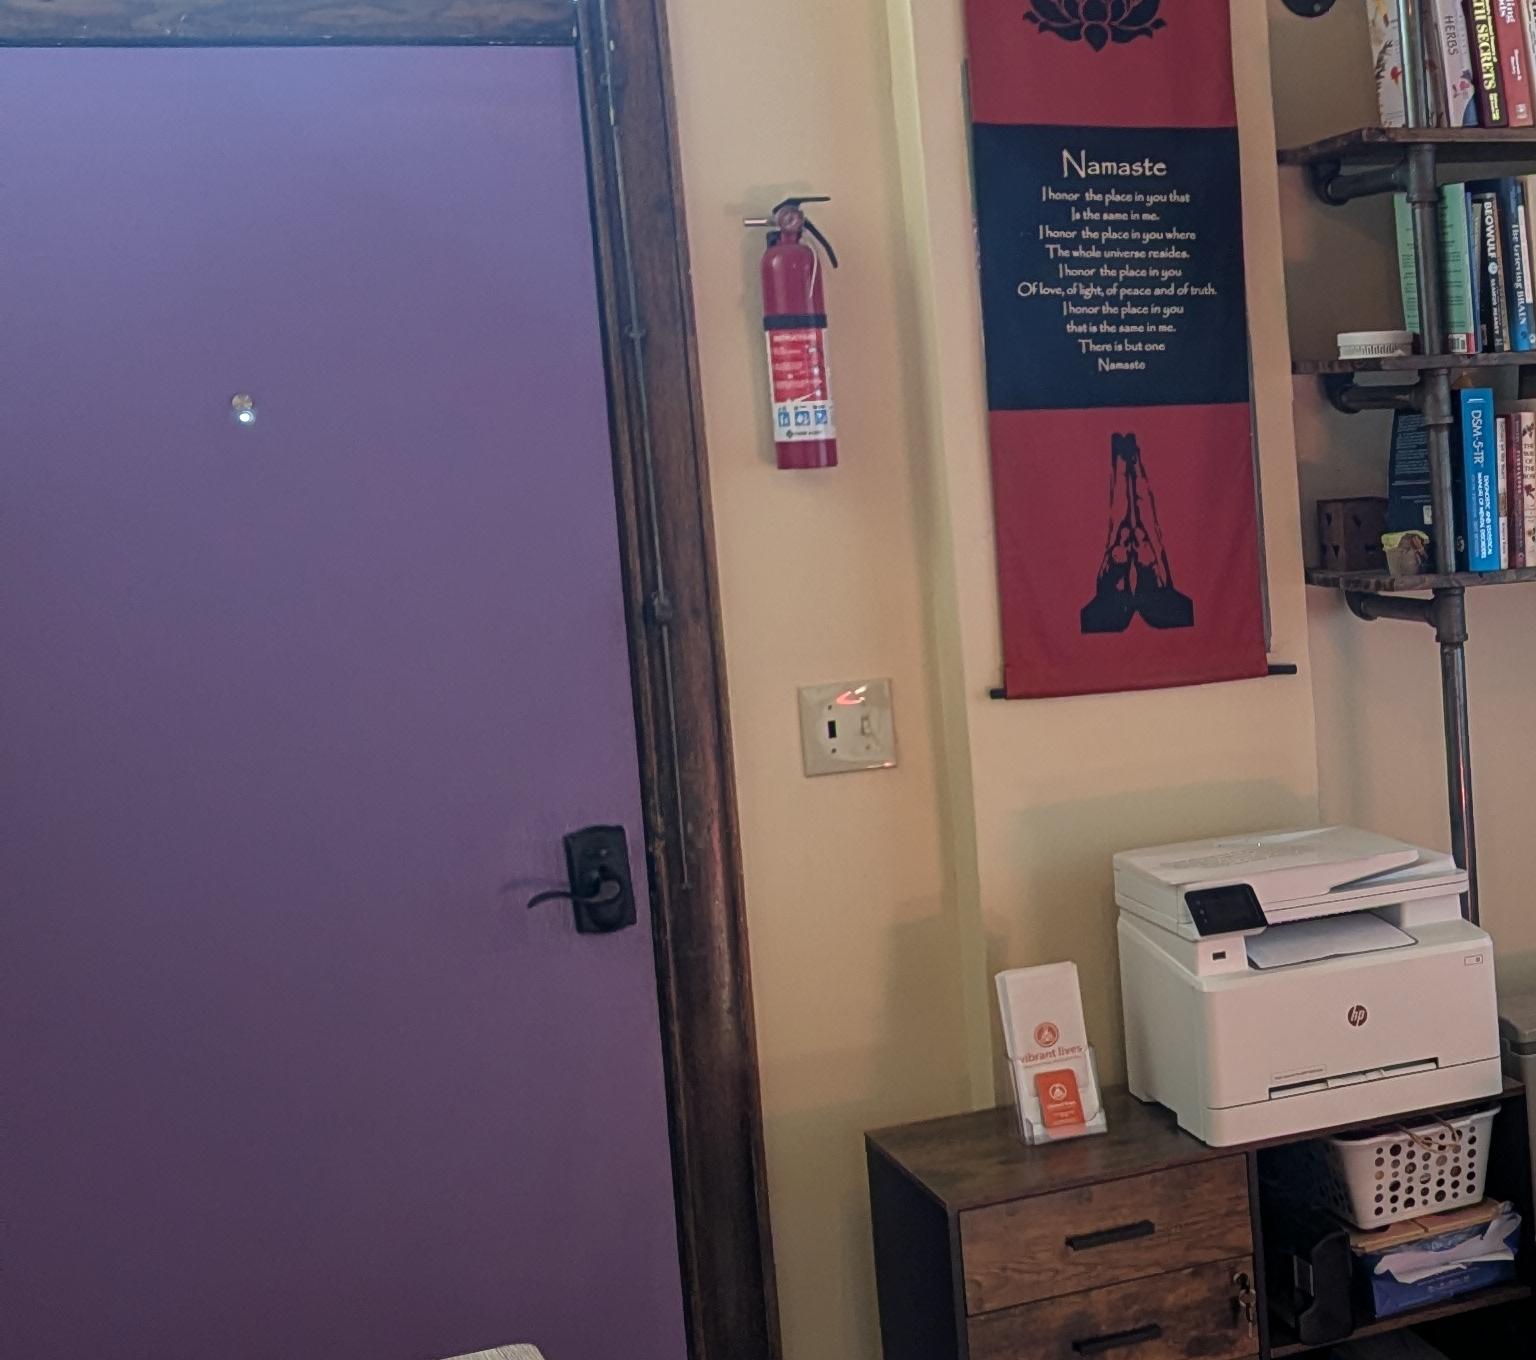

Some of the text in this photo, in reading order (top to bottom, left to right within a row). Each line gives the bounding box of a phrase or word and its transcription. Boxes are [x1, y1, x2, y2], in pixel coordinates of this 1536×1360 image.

[1444, 16, 1459, 56] HERBS
[1476, 24, 1497, 90] SECRETS
[1062, 148, 1168, 178] Namaste
[1049, 190, 1080, 202] honor
[1086, 189, 1103, 202] the
[1105, 190, 1132, 205] place
[1134, 191, 1144, 202] in
[1146, 192, 1167, 206] you
[1169, 190, 1190, 202] that
[1083, 210, 1100, 220] the
[1102, 212, 1128, 220] same
[1130, 210, 1140, 220] in
[1142, 212, 1160, 221] me.
[1046, 226, 1077, 239] honor
[1082, 227, 1099, 239] the
[1102, 227, 1130, 243] place
[1131, 229, 1140, 239] in
[1142, 231, 1163, 244] you
[1166, 228, 1196, 240] where
[1481, 201, 1497, 258] BEOWULF
[1045, 244, 1070, 259] The
[1072, 246, 1102, 258] whole
[1104, 248, 1146, 258] universe
[1065, 264, 1095, 277] honor
[1100, 264, 1117, 277] the
[1119, 266, 1147, 280] place
[1149, 267, 1159, 277] in
[1161, 269, 1182, 280] you
[1018, 282, 1038, 296] Of
[1066, 283, 1077, 296] of
[1106, 283, 1118, 296] of
[1119, 287, 1151, 300] peace
[1154, 284, 1174, 296] and
[1177, 283, 1188, 296] of
[1069, 303, 1099, 314] honor
[1102, 303, 1118, 314] the
[1121, 303, 1148, 318] place
[1150, 304, 1160, 314] in
[1163, 306, 1184, 317] you
[1516, 290, 1527, 324] BRAIN
[1066, 322, 1176, 333] that is the same in me.
[1078, 339, 1165, 354] There is but one
[1098, 358, 1145, 372] Namaste
[1471, 409, 1483, 464] DSM-5-TR
[1348, 1005, 1368, 1027] hp
[1020, 1044, 1083, 1064] vibrant lives
